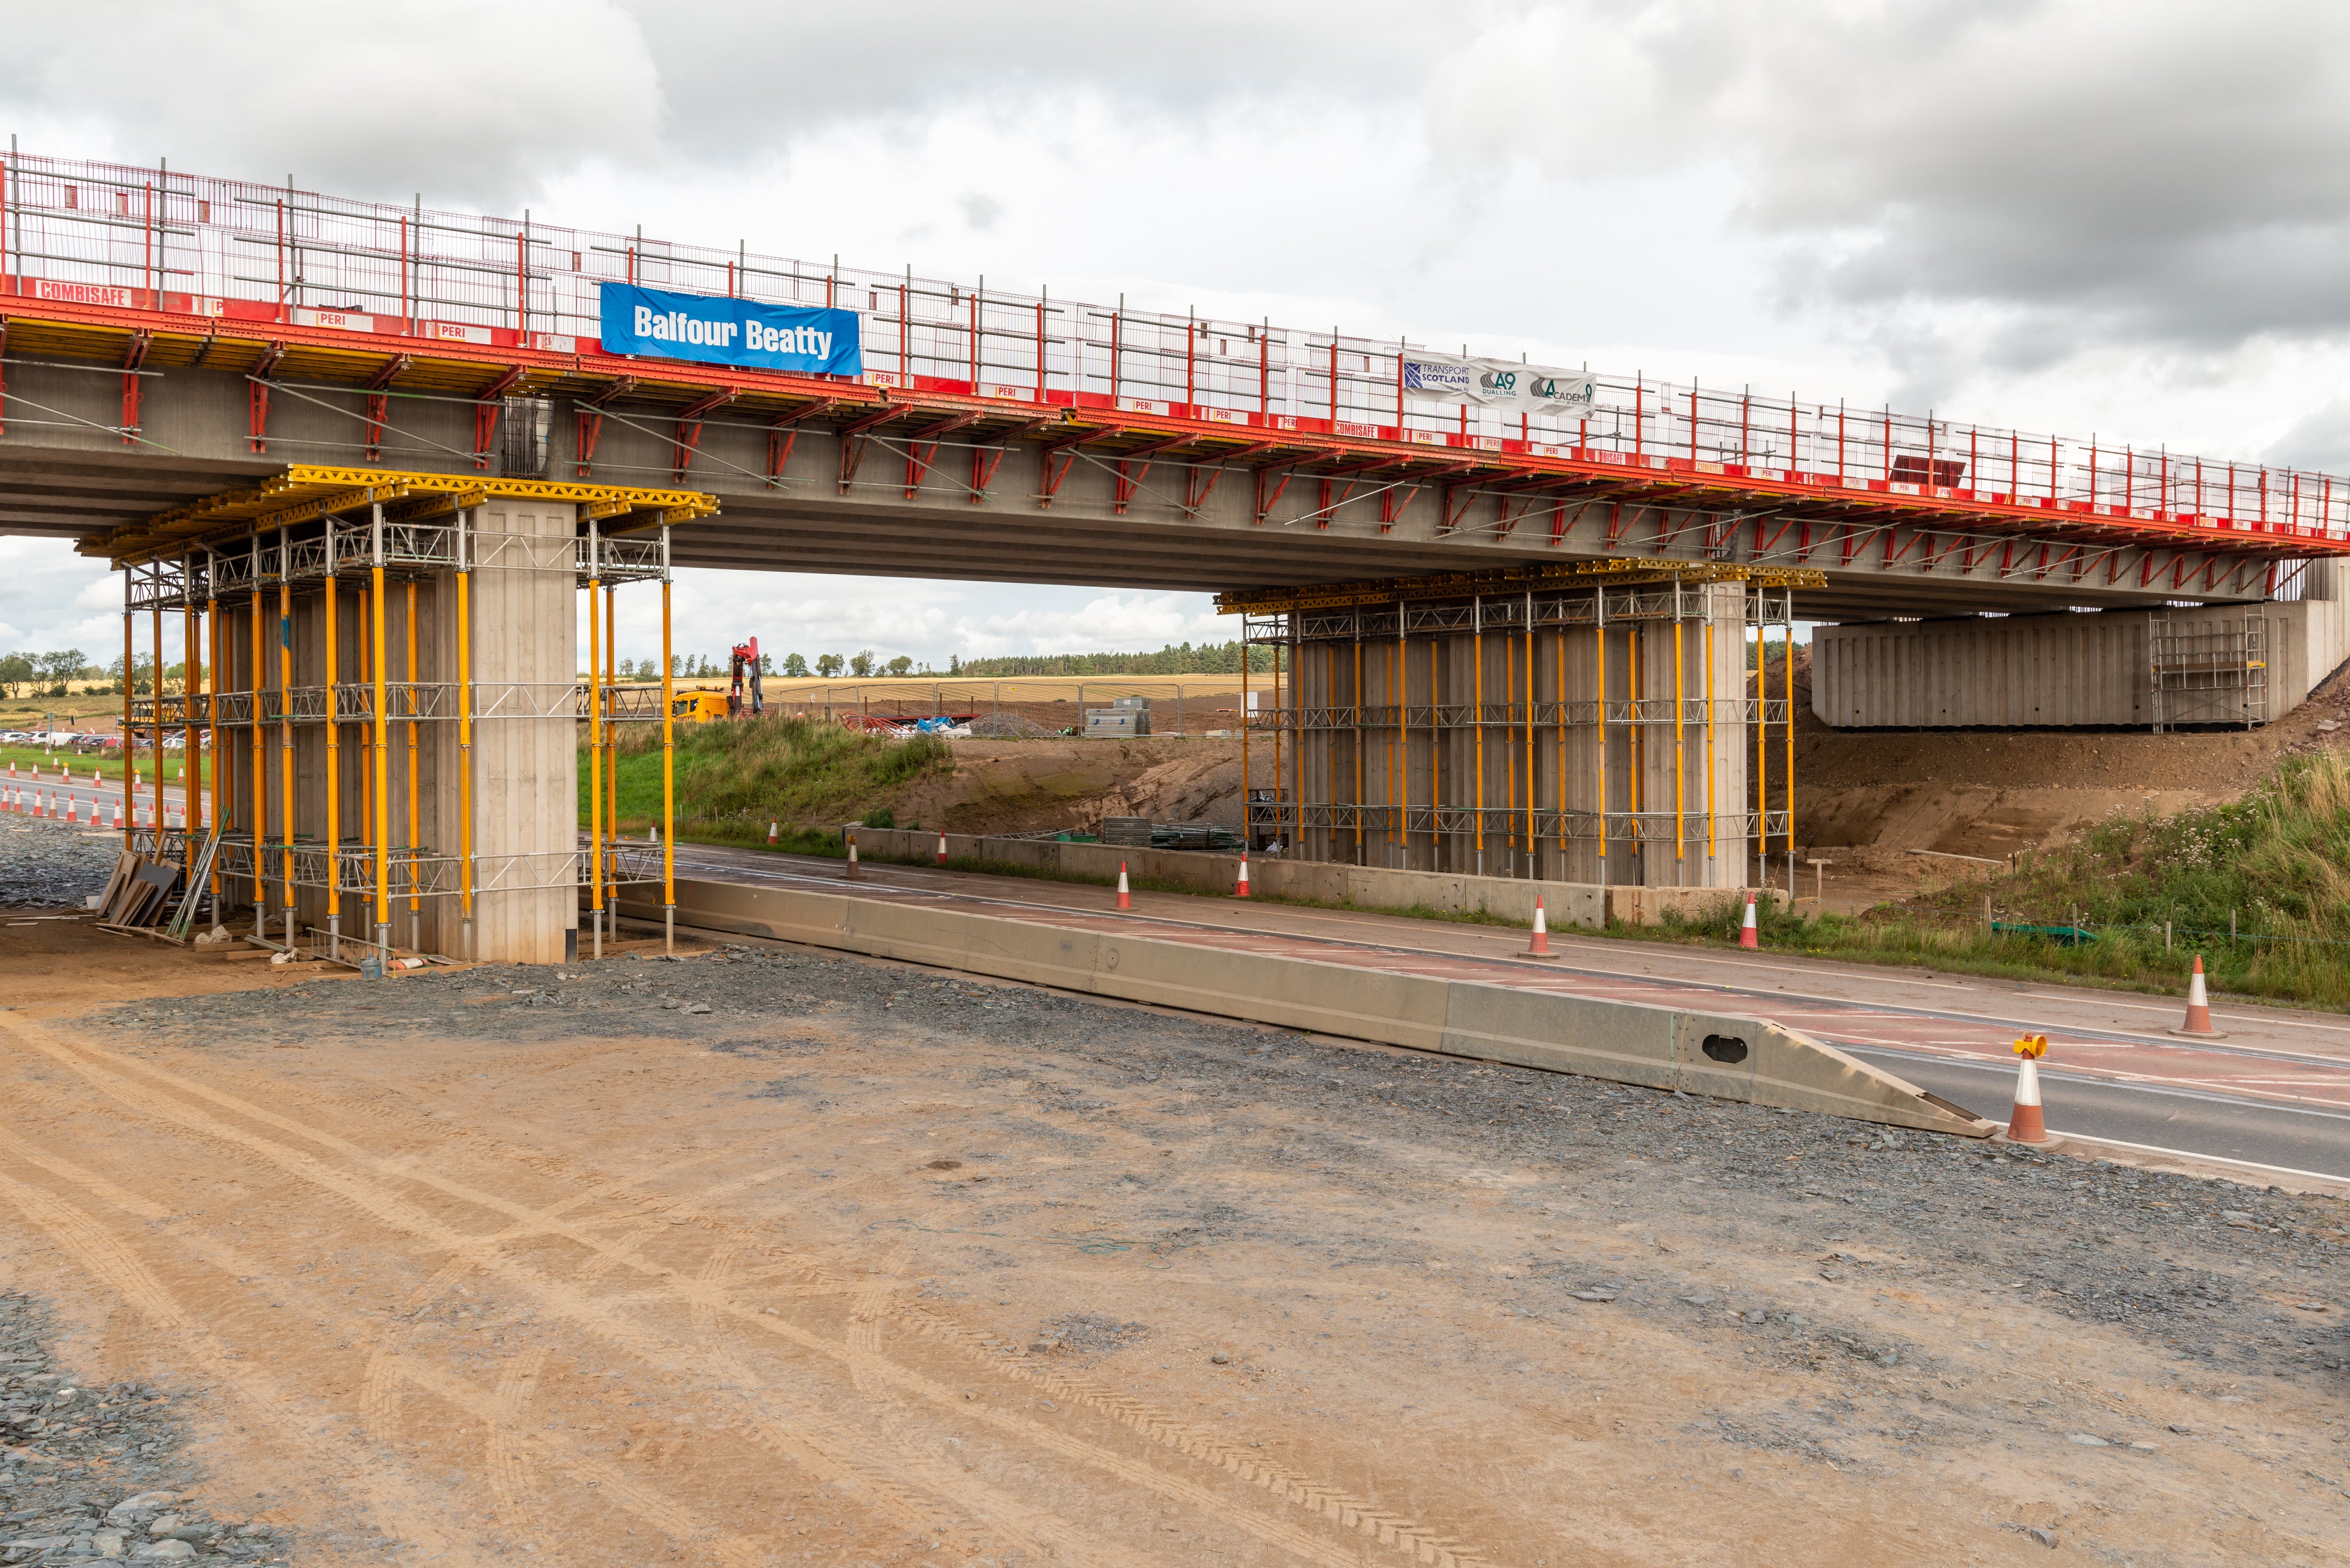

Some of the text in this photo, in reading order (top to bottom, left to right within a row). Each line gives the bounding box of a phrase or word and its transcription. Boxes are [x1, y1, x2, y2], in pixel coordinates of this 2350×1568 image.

[41, 281, 124, 306] COMBISAFE
[320, 313, 346, 326] PERI
[442, 326, 465, 338] PERI
[634, 305, 833, 361] Balfour Beatty
[1422, 364, 1470, 375] TRANSPORT
[875, 373, 894, 384] PERI
[1422, 374, 1470, 384] SCOTLAND
[1494, 372, 1516, 390] A9
[998, 386, 1016, 397] PERI
[1482, 388, 1517, 396] DUALLING
[1136, 401, 1152, 411] PERI
[1216, 410, 1231, 420] PERI
[1419, 432, 1433, 441] PERI
[1486, 439, 1499, 447] PERI
[1546, 447, 1558, 455] PERI
[1602, 452, 1623, 464] BISAFE
[1697, 462, 1725, 475] COMBISAF
[2200, 517, 2216, 527] MBISAFE
